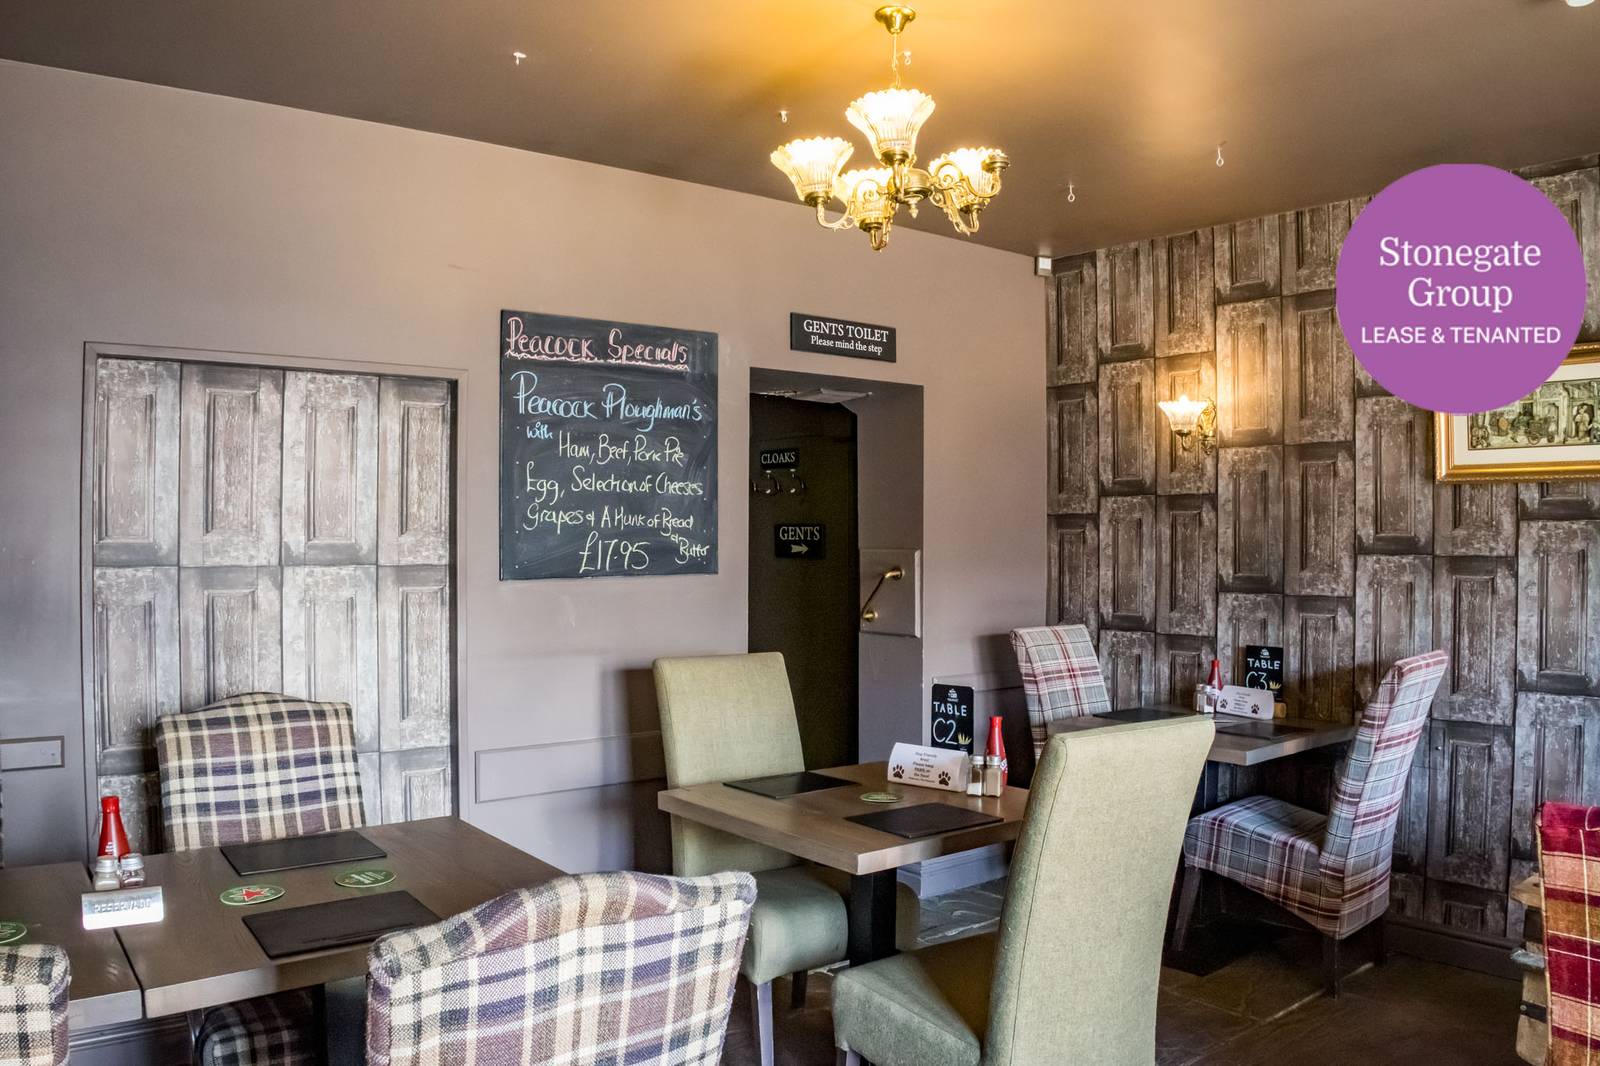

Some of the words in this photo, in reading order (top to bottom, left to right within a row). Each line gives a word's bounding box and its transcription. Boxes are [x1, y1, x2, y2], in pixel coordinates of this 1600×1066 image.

[506, 317, 595, 358] Peacock
[608, 328, 688, 364] Specials
[803, 319, 845, 337] GENTS
[846, 325, 889, 342] TOILET
[811, 335, 834, 347] Please
[835, 340, 854, 350] mind
[855, 342, 867, 352] the
[868, 344, 883, 356] step
[510, 371, 598, 419] Peacock
[602, 383, 703, 432] Ploughman's
[526, 421, 553, 440] with
[761, 451, 796, 464] CLOAKS
[526, 461, 566, 505] Egg,
[523, 503, 584, 534] Grapes
[601, 505, 611, 528] A
[647, 514, 661, 529] of
[779, 526, 820, 541] GENTS
[579, 531, 650, 573] £17.95
[1247, 658, 1281, 670] TABLE
[1246, 671, 1268, 691] C3
[933, 701, 967, 717] TABLE
[933, 718, 958, 745] C2
